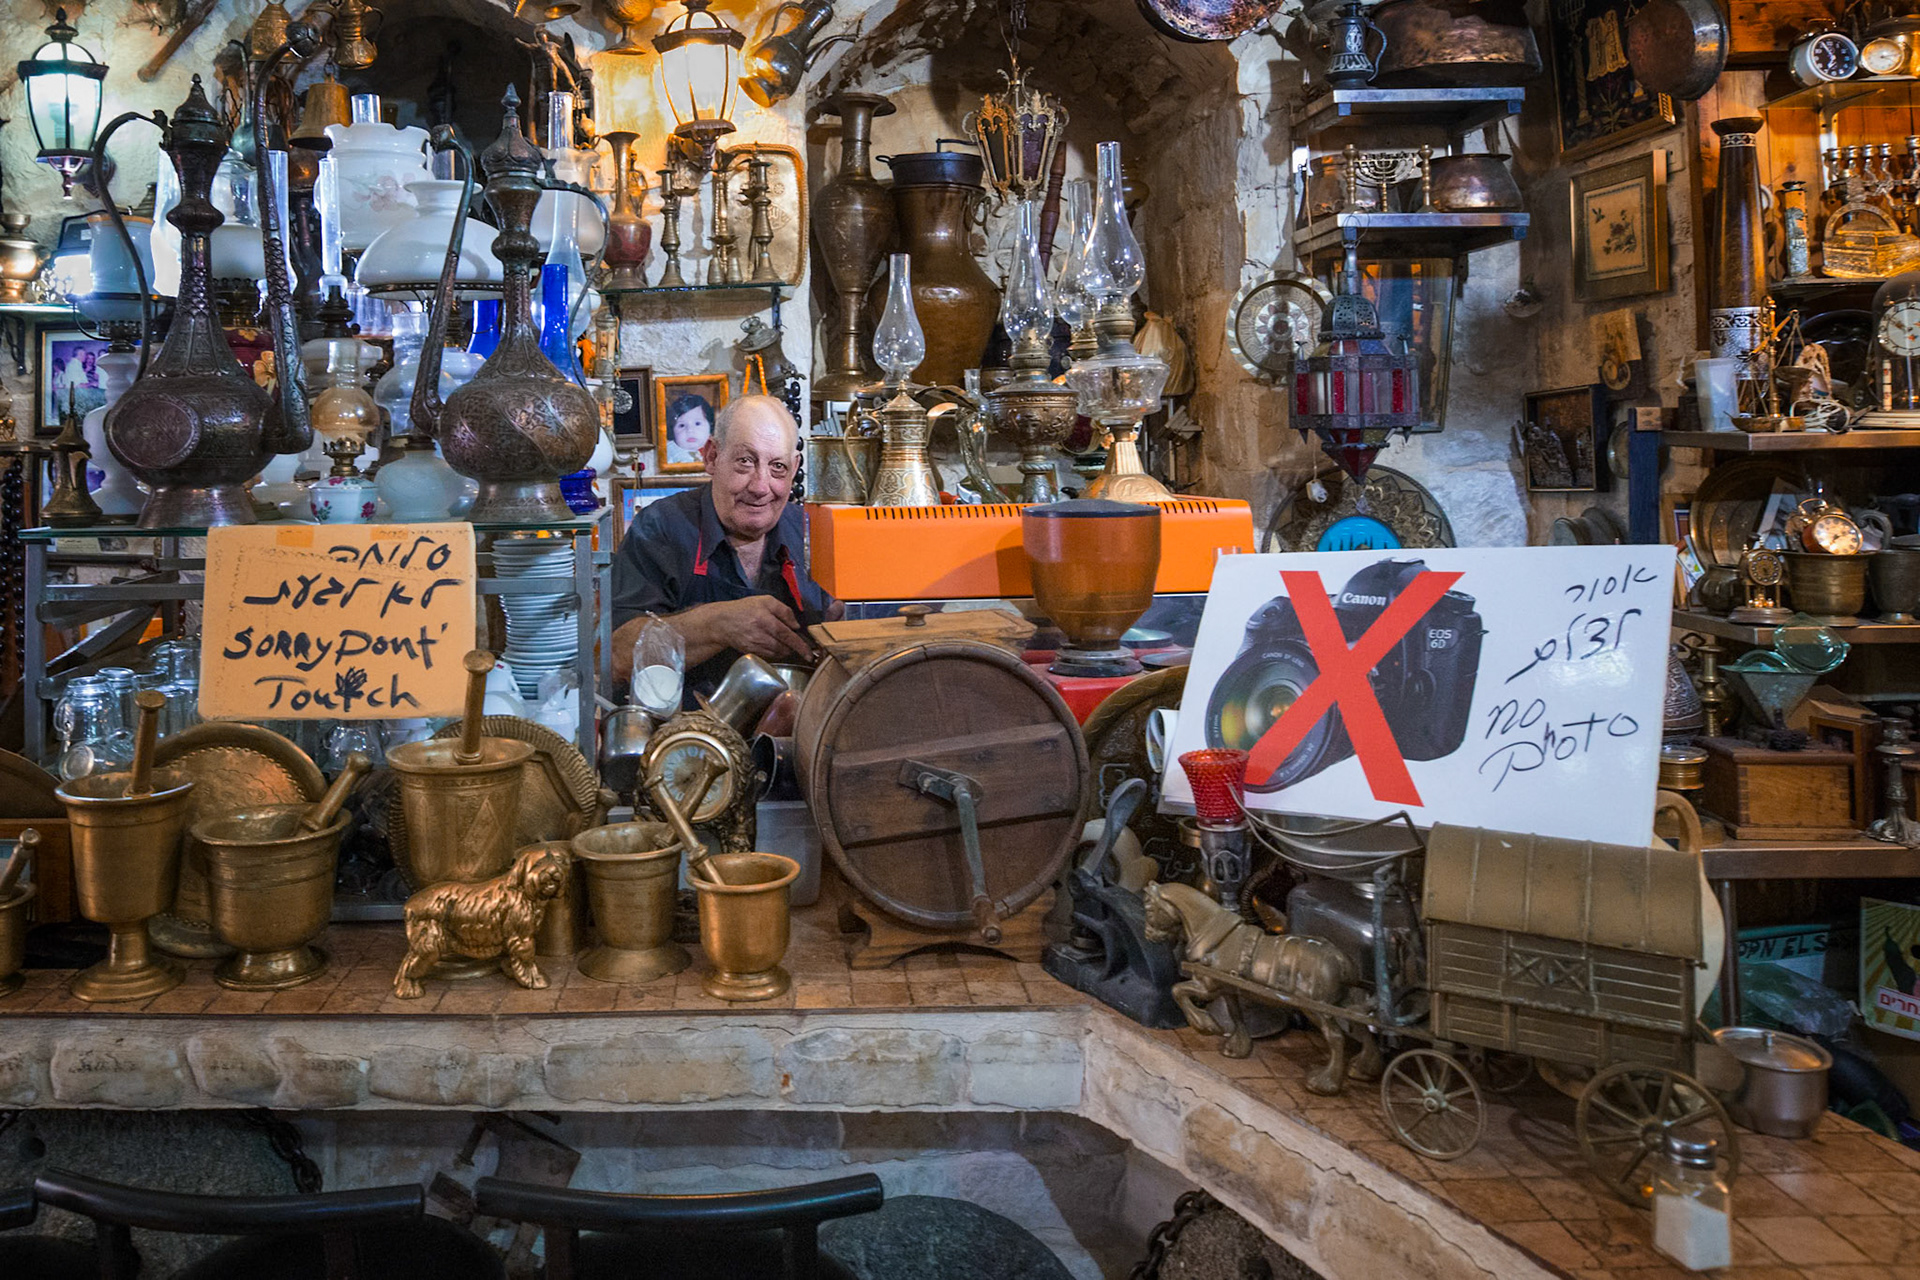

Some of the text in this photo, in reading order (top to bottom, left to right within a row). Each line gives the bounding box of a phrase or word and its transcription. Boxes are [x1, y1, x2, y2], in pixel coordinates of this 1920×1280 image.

[1564, 564, 1658, 603] אסור
[243, 573, 464, 619] לא לגעת
[1341, 592, 1388, 607] Canon
[1428, 628, 1453, 640] EOS
[1430, 638, 1447, 649] 6D
[1504, 608, 1642, 685] לצלם
[1880, 993, 1920, 1016] חרים
